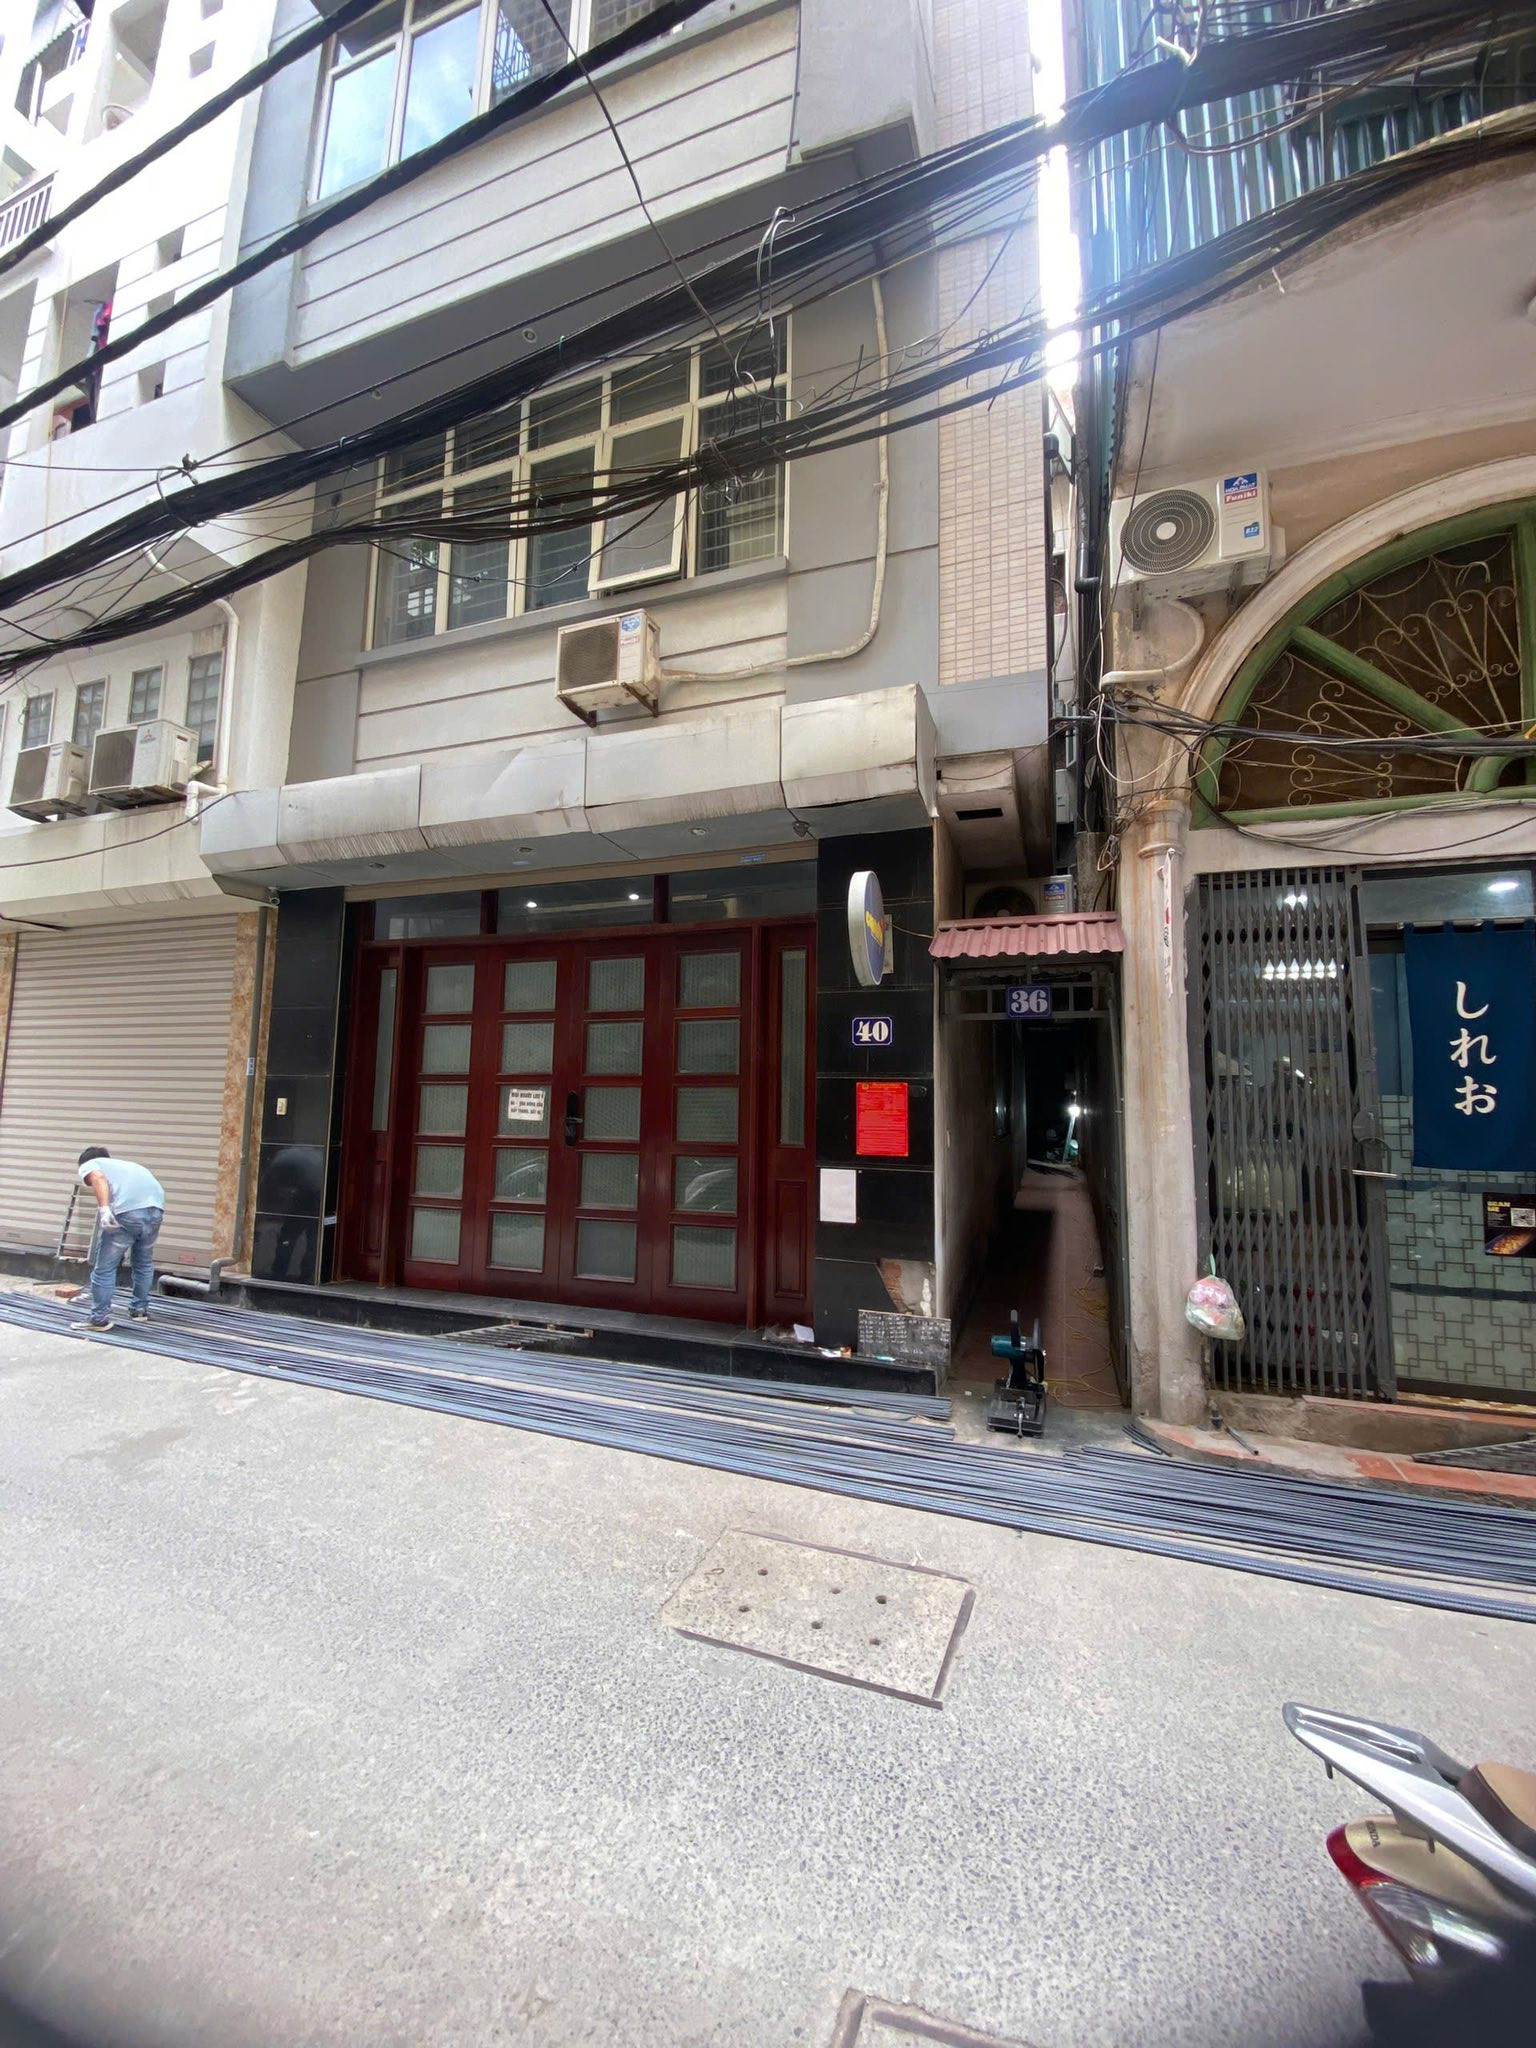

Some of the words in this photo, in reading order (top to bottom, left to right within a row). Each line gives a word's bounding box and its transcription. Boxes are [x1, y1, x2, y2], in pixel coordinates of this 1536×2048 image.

[1226, 490, 1257, 503] Funiki
[1010, 989, 1048, 1013] 36
[856, 1021, 889, 1042] 40
[1450, 981, 1497, 1115] しれお
